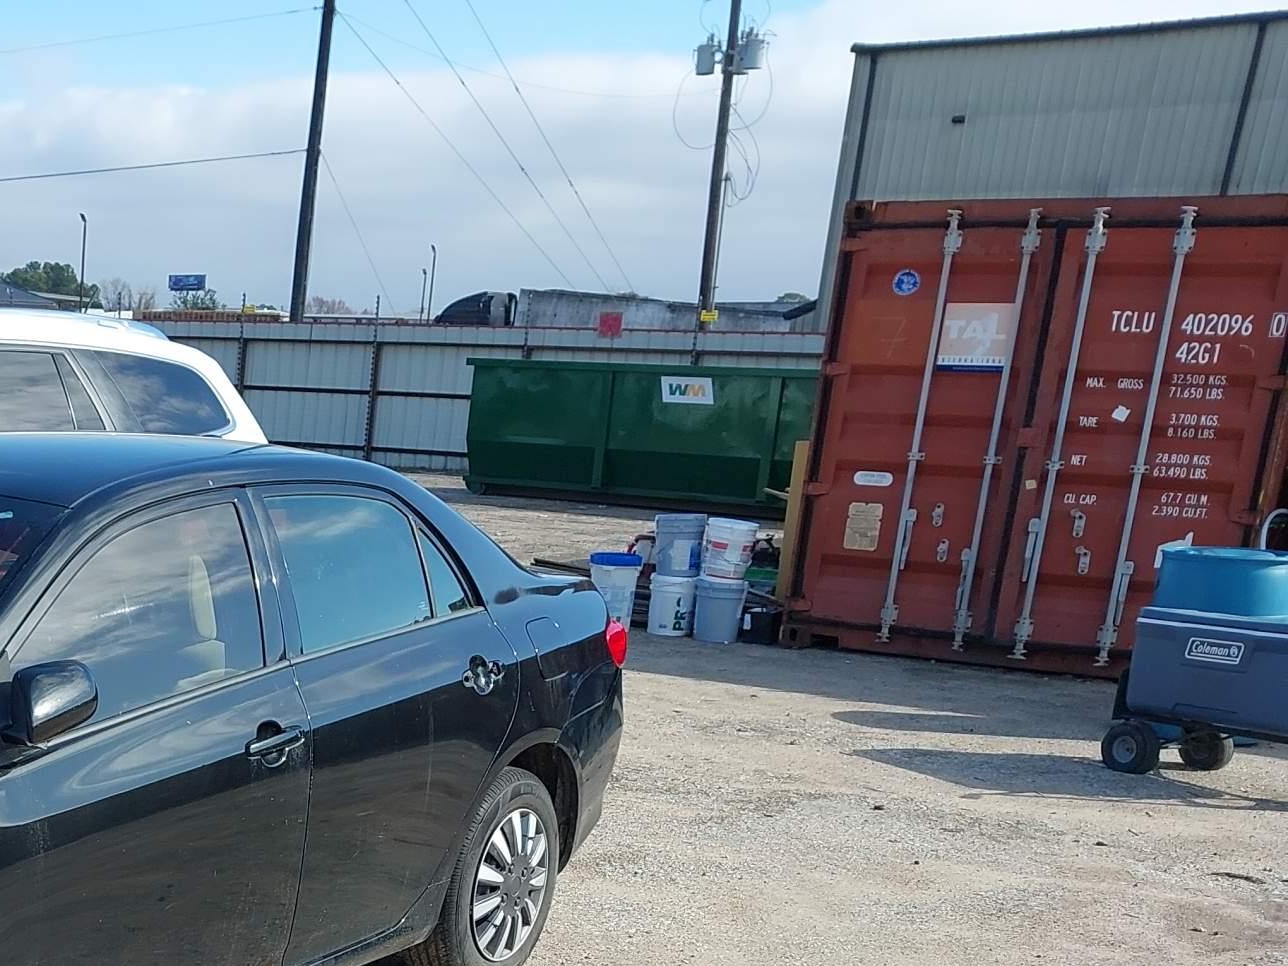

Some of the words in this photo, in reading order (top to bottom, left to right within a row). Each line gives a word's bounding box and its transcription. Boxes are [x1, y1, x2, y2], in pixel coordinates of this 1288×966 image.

[1112, 310, 1155, 333] TCLU
[1181, 312, 1254, 336] 402096
[1272, 314, 1286, 336] 0
[1176, 342, 1220, 364] 42G1
[1117, 378, 1144, 390] GROSS
[1171, 373, 1205, 385] 32.500
[669, 383, 706, 397] WM
[1169, 387, 1203, 399] 71.650
[1169, 413, 1197, 425] 3.700
[1070, 455, 1087, 466] NET
[1153, 467, 1187, 479] 63.490
[1079, 494, 1097, 505] CAP.
[1161, 492, 1182, 504] 67.7
[1152, 505, 1179, 517] 2.390
[1192, 641, 1229, 656] Coleman
